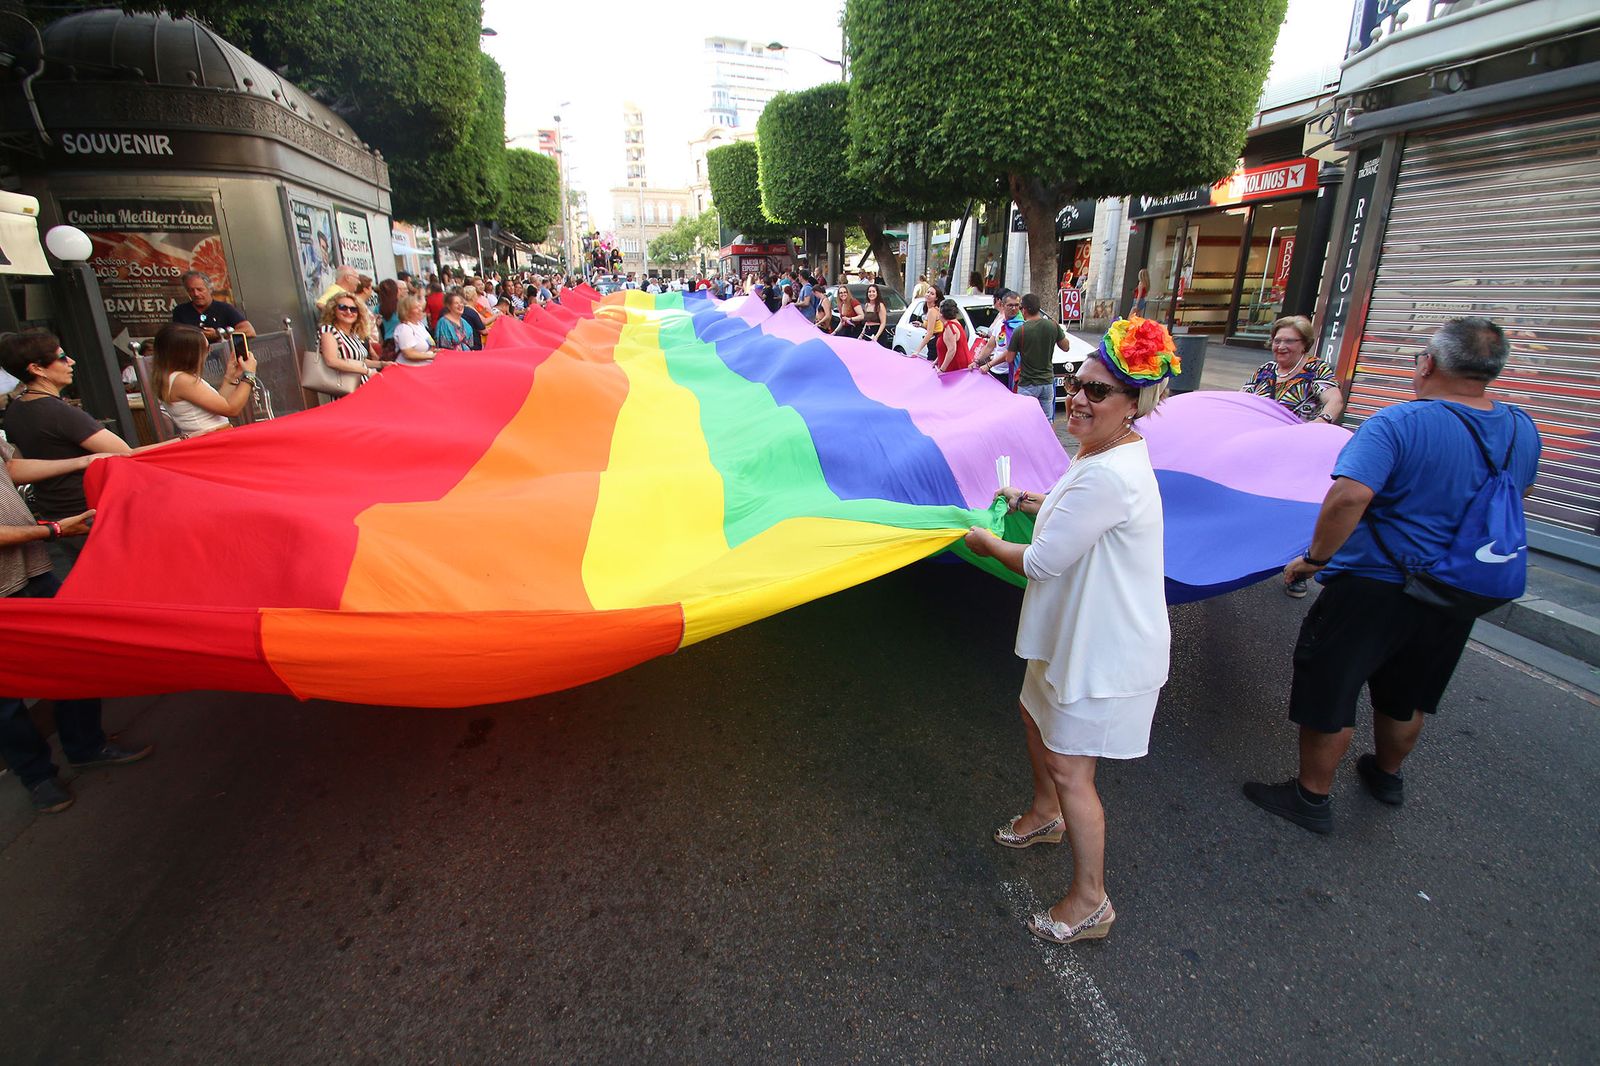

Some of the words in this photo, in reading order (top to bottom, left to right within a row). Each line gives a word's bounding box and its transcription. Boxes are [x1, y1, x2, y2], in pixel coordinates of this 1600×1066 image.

[62, 133, 174, 155] SOUVENIR
[1233, 169, 1286, 195] KOLINOS
[1151, 190, 1198, 207] MARTINELLI
[68, 209, 116, 224] Cocina
[118, 208, 213, 225] Mediterránea
[348, 221, 358, 235] SE
[341, 237, 370, 253] NECESITA
[127, 262, 181, 278] Botas
[1064, 291, 1079, 303] 70
[104, 298, 178, 313] BAVIERA
